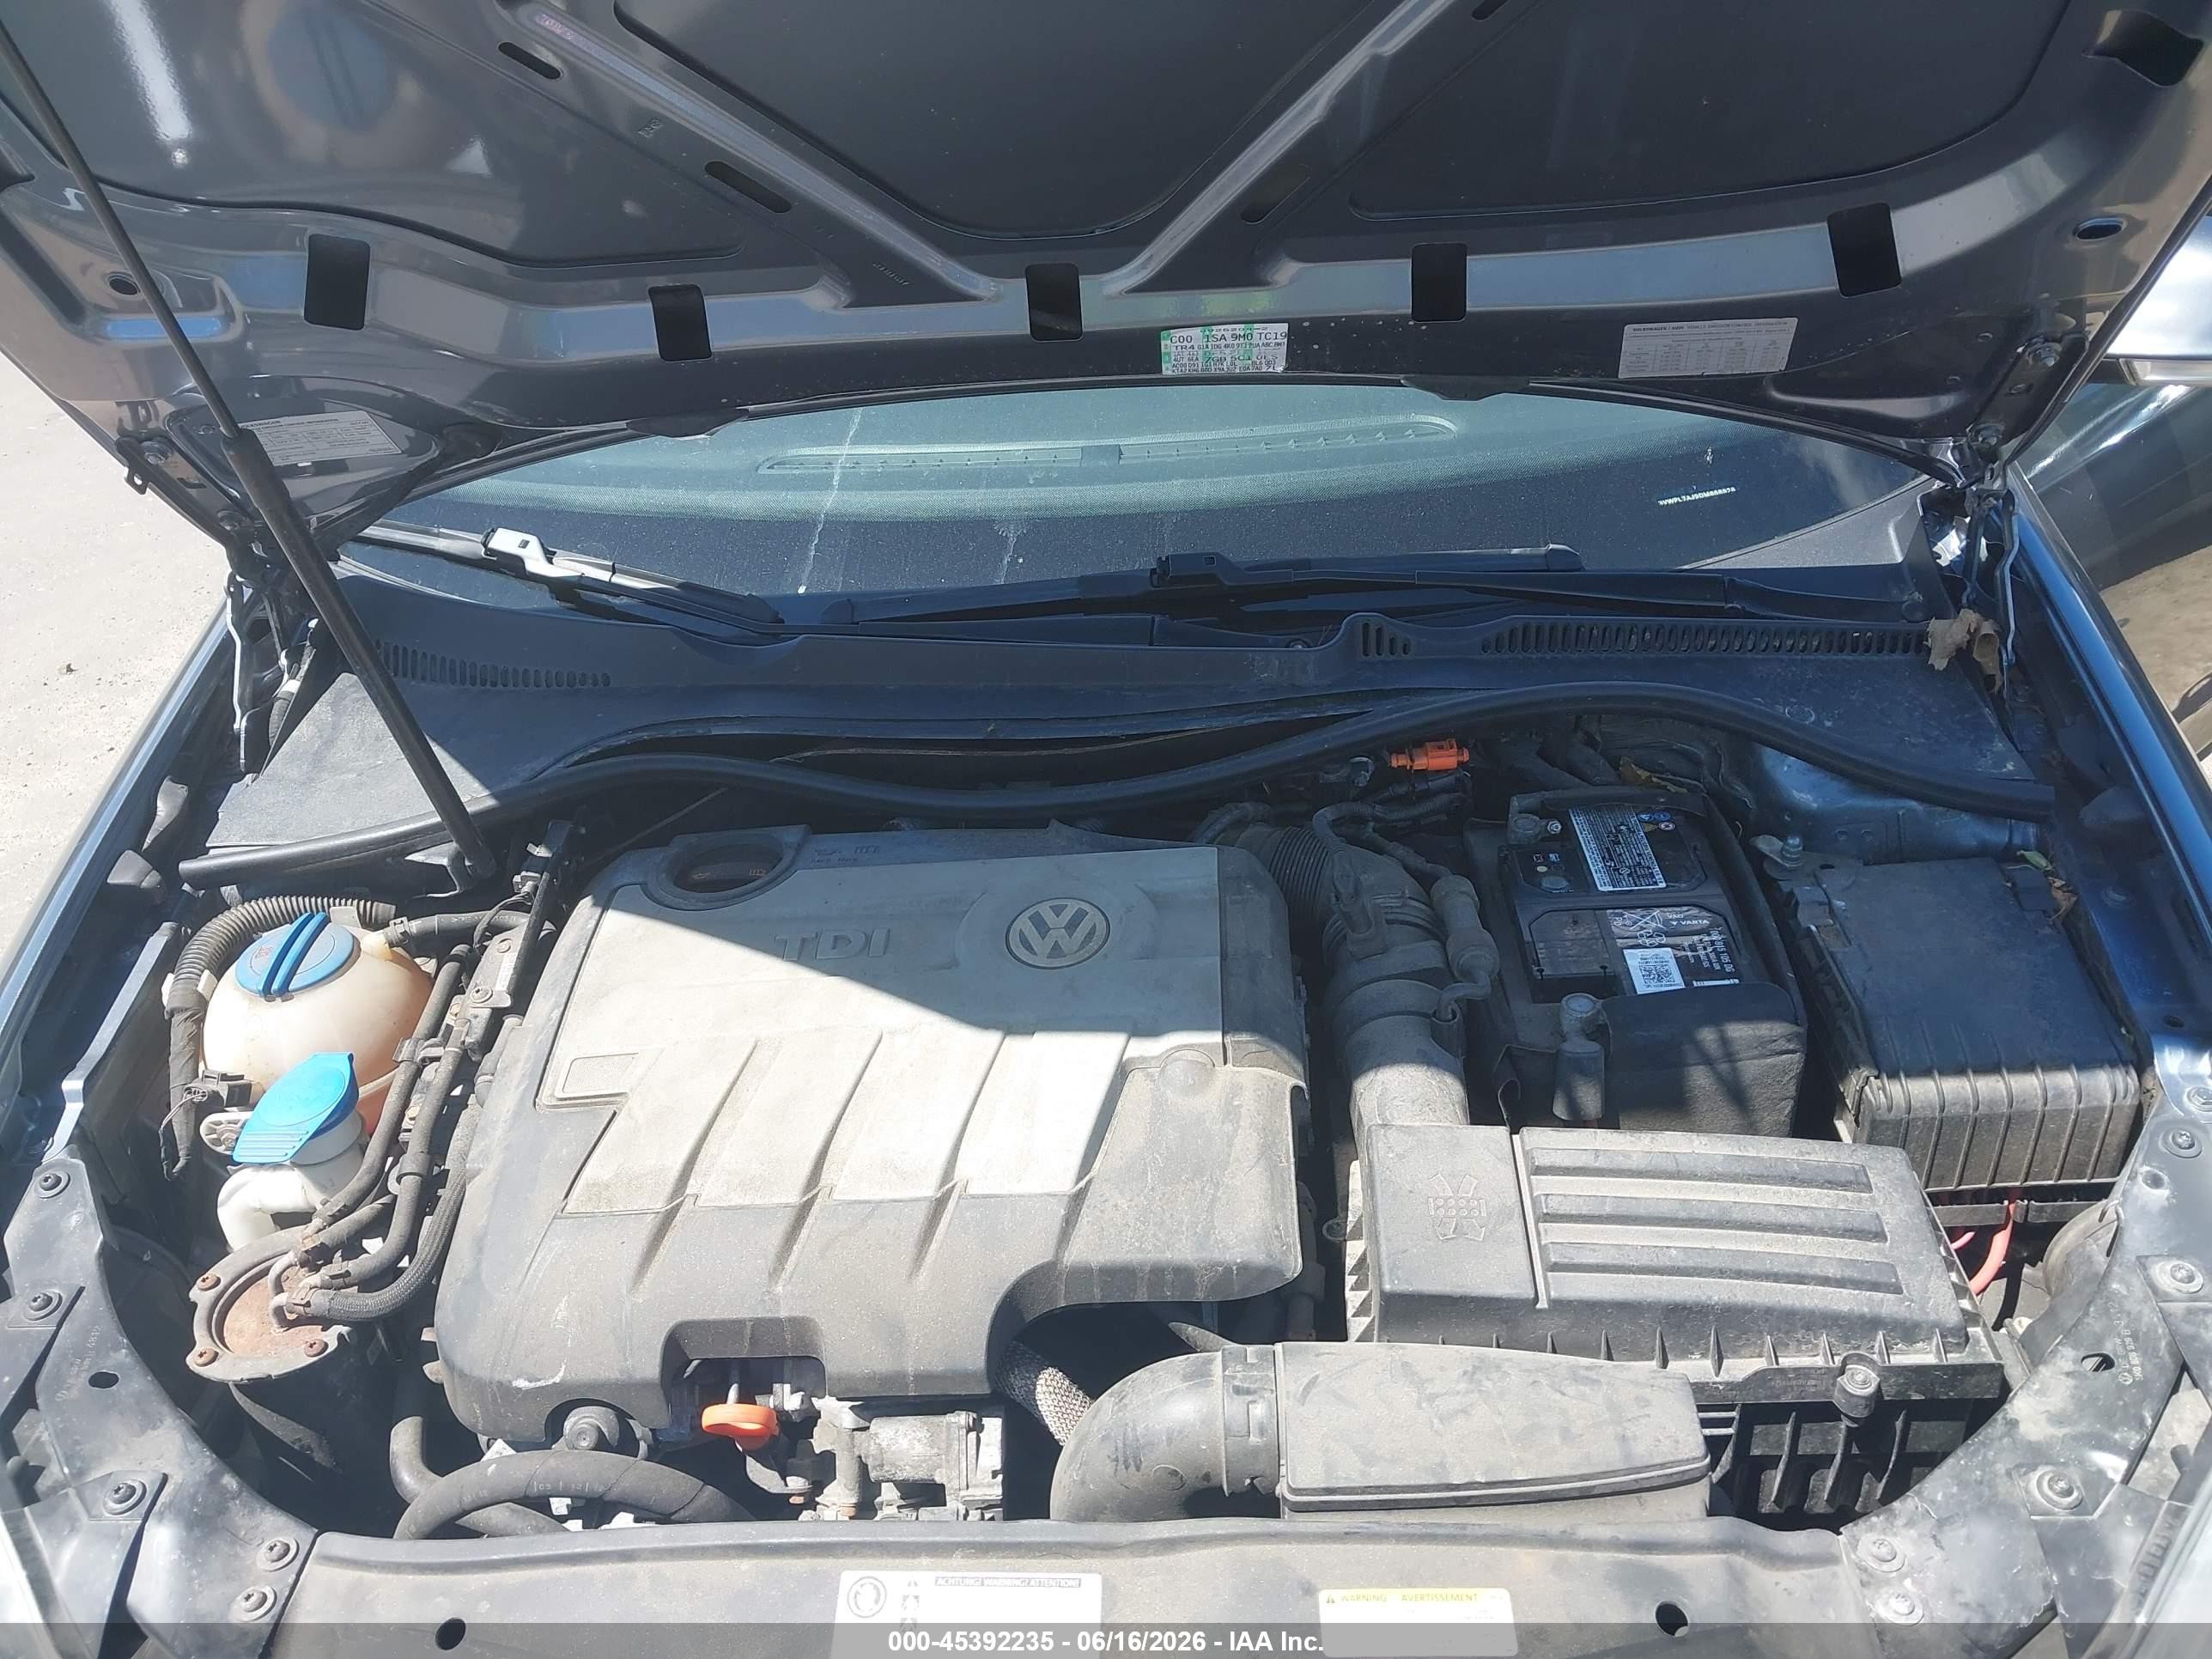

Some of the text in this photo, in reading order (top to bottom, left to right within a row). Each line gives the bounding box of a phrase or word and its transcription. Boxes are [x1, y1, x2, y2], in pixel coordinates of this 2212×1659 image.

[1170, 331, 1287, 343] C00 1SA 9M0 TC19
[1012, 901, 1105, 965] VW
[774, 928, 890, 961] TDI
[937, 1577, 1081, 1589] ACHTUNG! WARNING! ATTENTION!
[1341, 1594, 1478, 1602] WARNING AVERTISSEMENT
